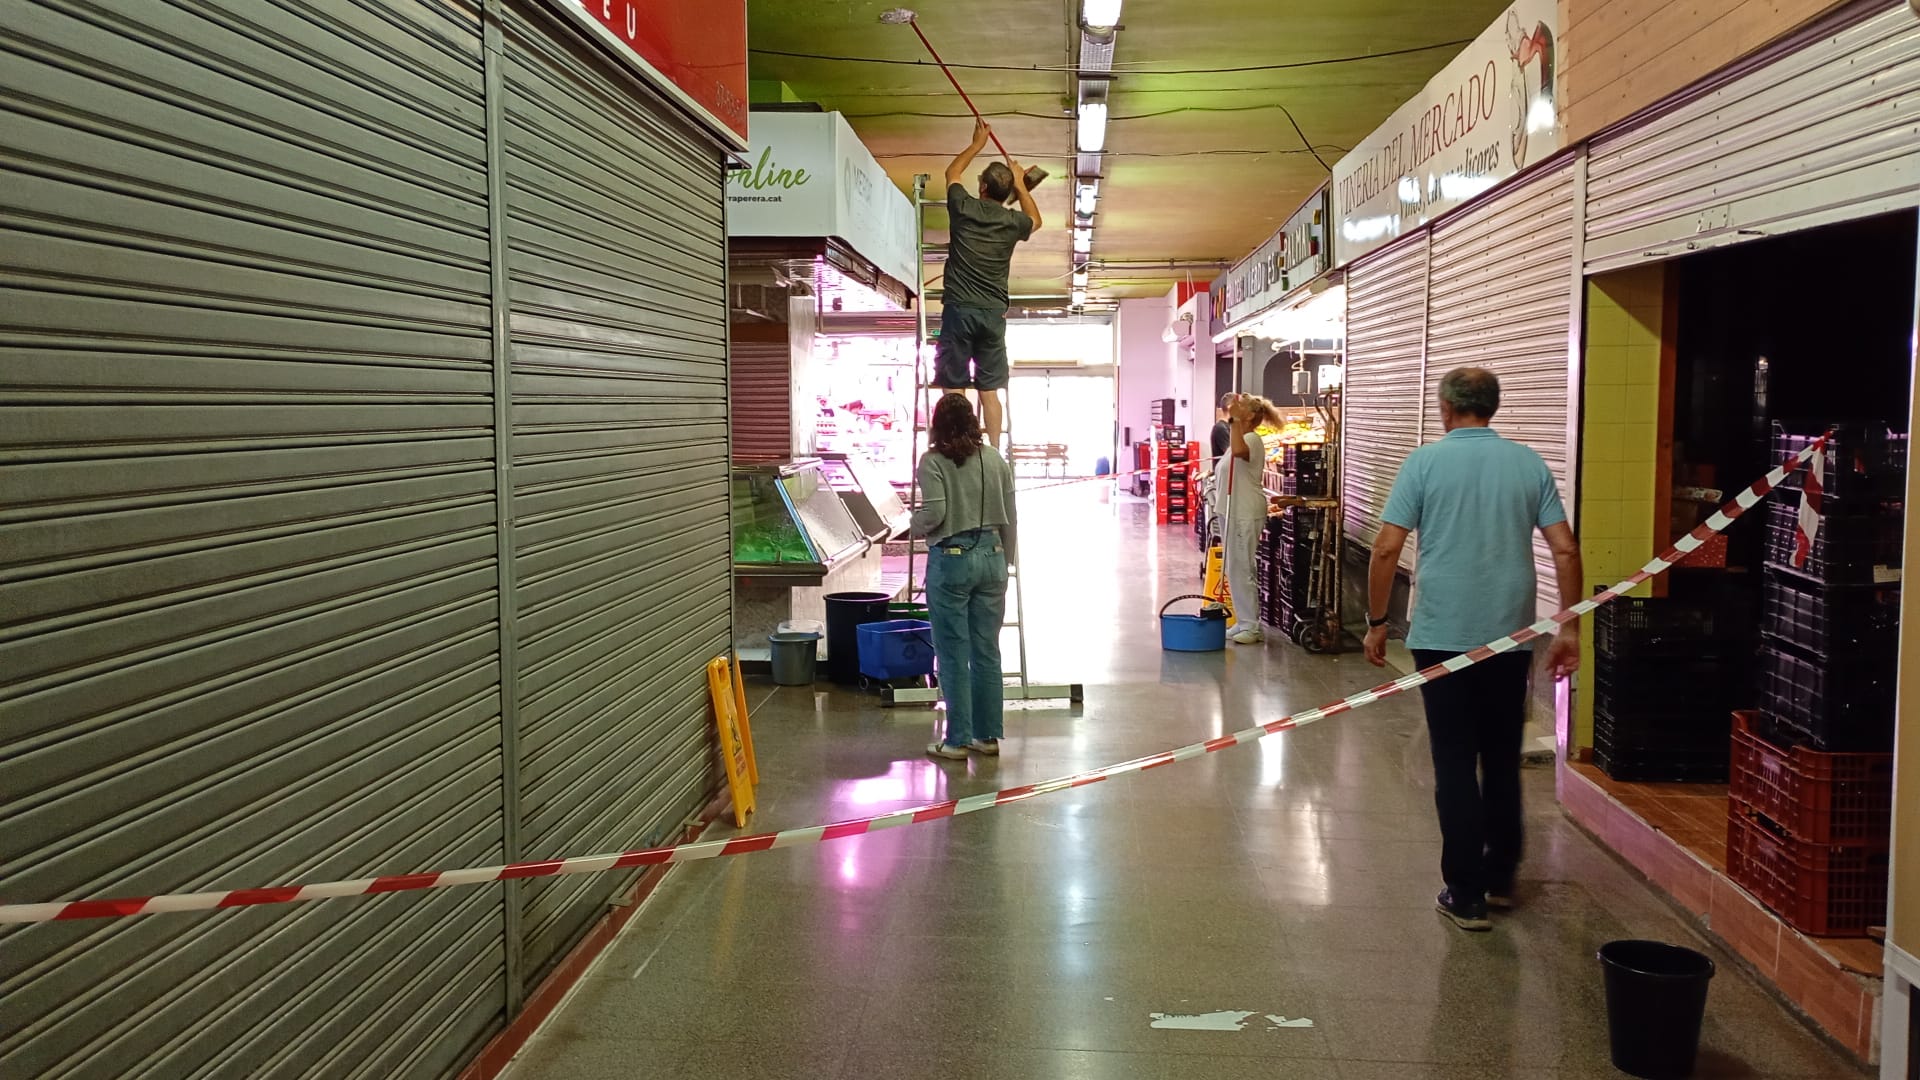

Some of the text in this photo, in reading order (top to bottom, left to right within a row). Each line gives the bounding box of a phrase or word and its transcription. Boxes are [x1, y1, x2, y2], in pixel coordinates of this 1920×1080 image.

[1338, 59, 1496, 216] VINERIA DEL MERCADO
[1464, 140, 1499, 180] licores
[727, 195, 782, 203] raperera.cat
[1283, 222, 1310, 270] PALMA
